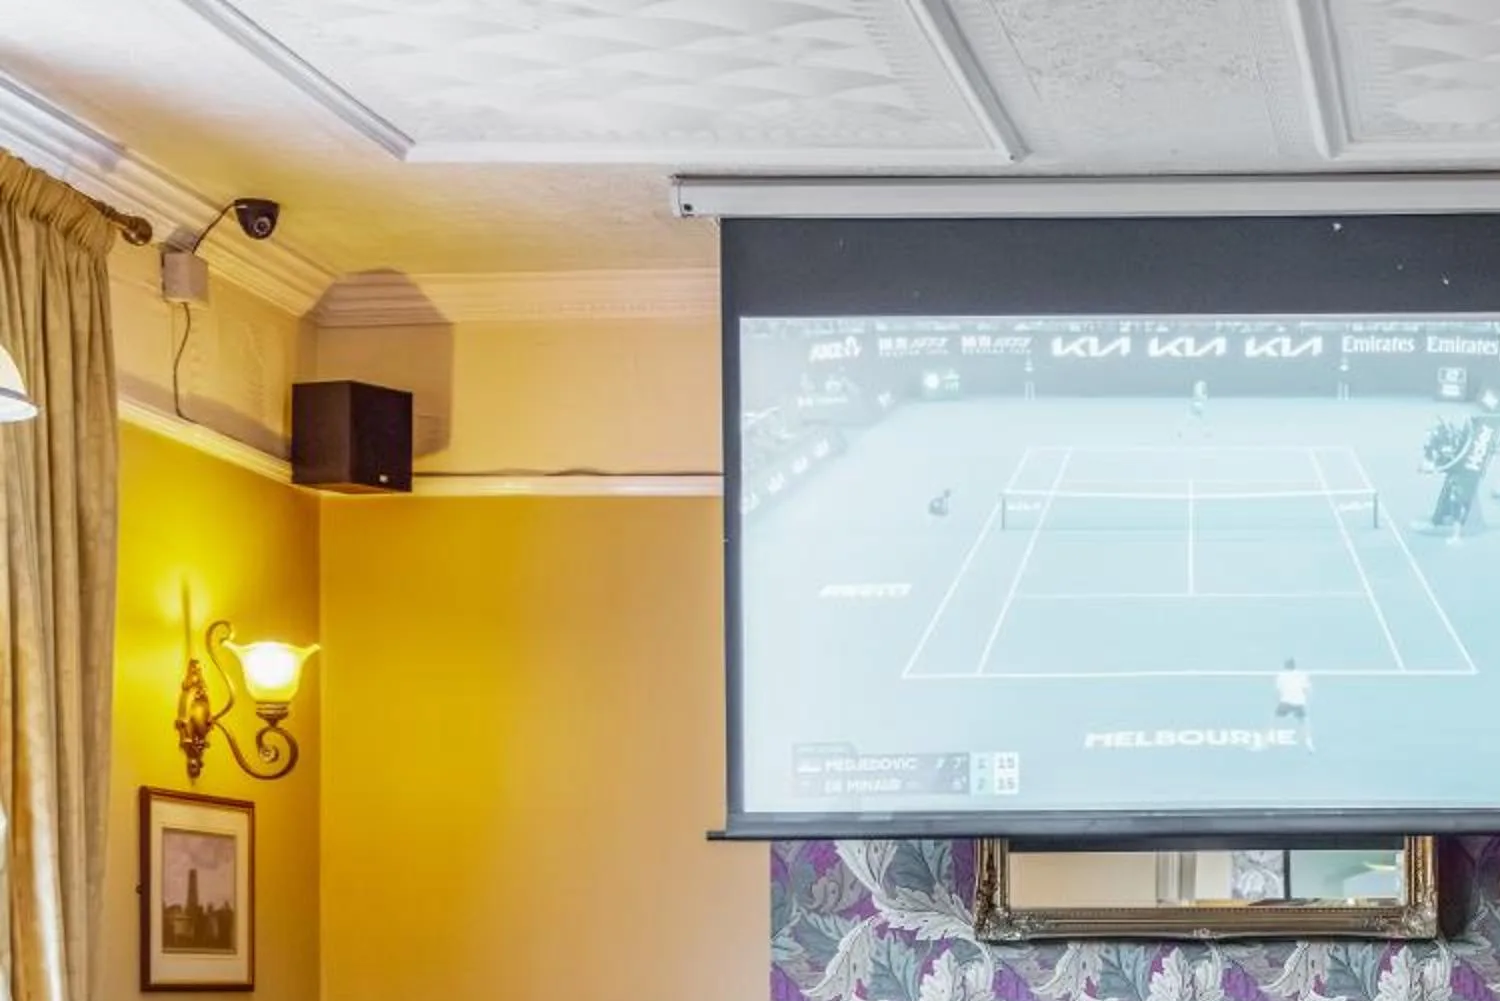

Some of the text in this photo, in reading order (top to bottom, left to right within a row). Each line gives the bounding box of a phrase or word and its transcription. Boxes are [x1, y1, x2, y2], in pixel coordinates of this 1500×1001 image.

[1051, 336, 1131, 357] KIA
[1148, 336, 1228, 357] KIA
[1245, 336, 1324, 357] KIA
[1342, 334, 1415, 354] Emirates
[1427, 335, 1499, 356] Emirates
